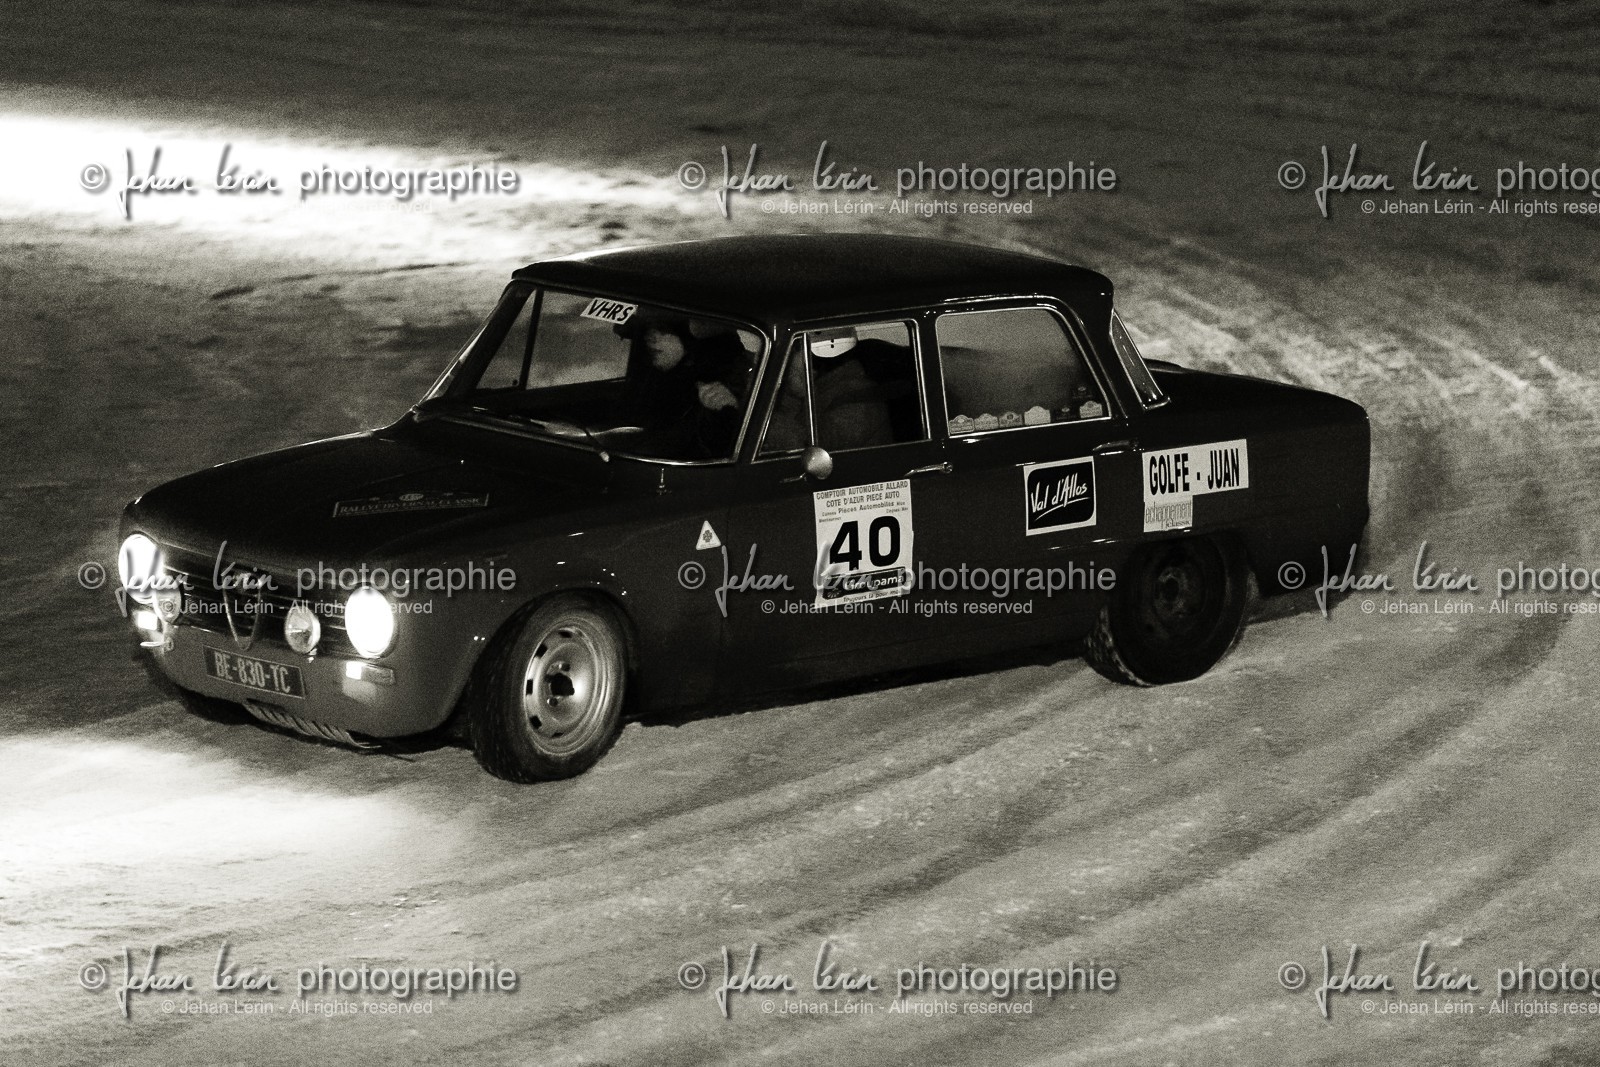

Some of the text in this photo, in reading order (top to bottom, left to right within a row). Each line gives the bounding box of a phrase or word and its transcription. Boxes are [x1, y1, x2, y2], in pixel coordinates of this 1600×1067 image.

[588, 299, 633, 321] VHRS
[816, 480, 909, 500] COMPTOIR AUTOMOBILE ALLARD
[1150, 452, 1190, 495] GOLFE
[1208, 448, 1240, 490] JUAN
[843, 496, 864, 505] D'AZUR
[866, 493, 882, 502] PIECE
[884, 490, 900, 499] AUTO
[1031, 472, 1088, 513] Val d'Allos
[829, 515, 900, 571] 40
[214, 651, 291, 694] BE-830-TC
